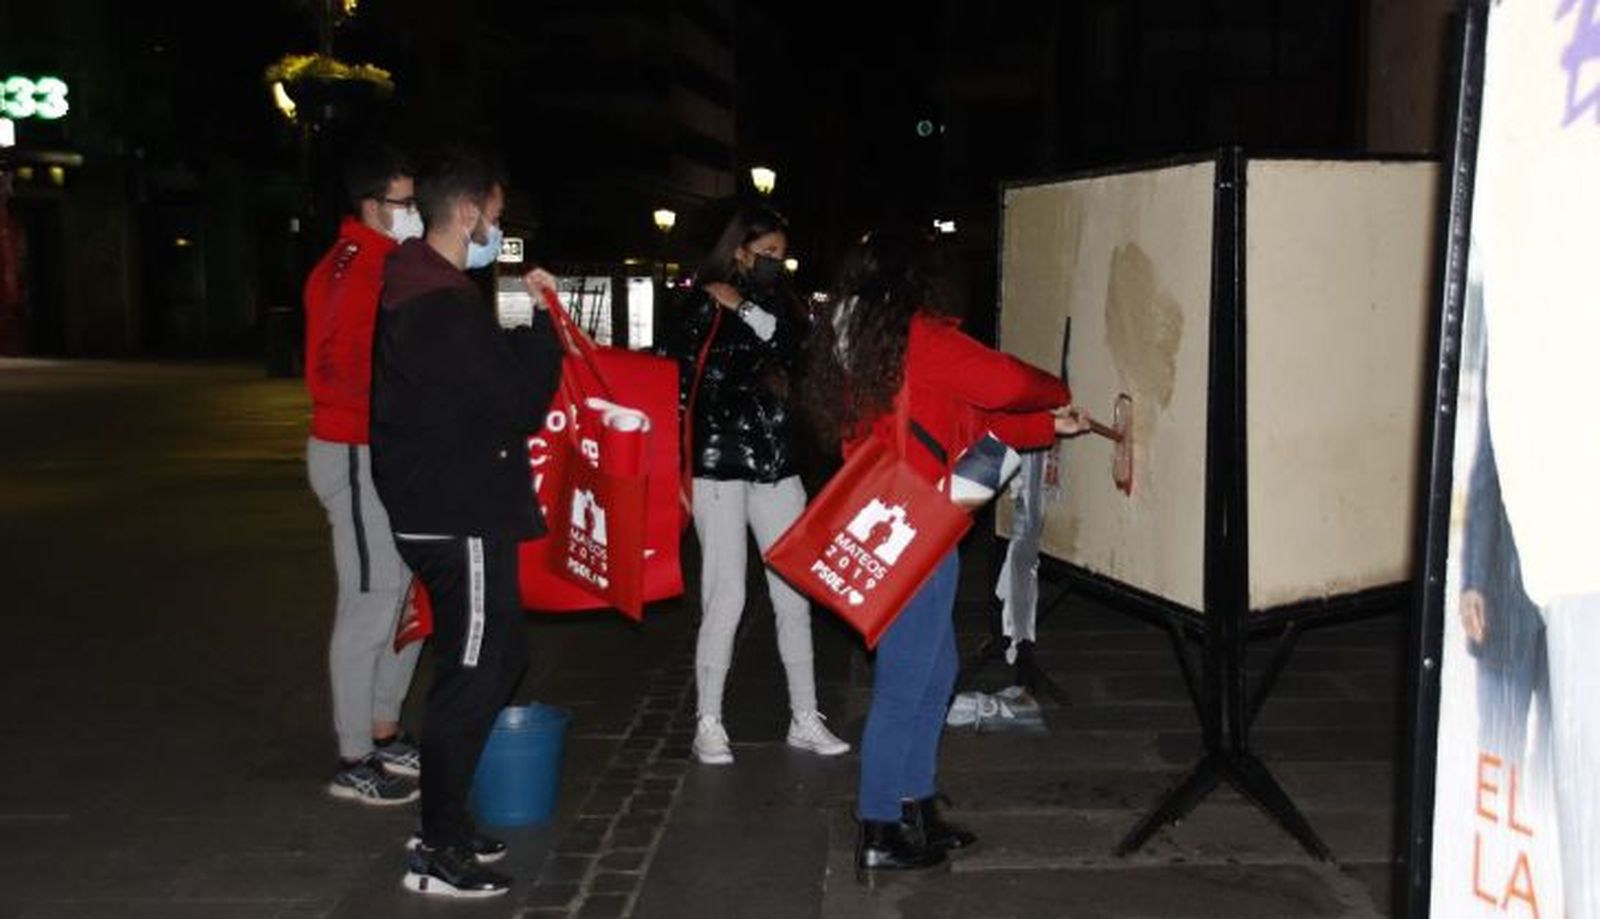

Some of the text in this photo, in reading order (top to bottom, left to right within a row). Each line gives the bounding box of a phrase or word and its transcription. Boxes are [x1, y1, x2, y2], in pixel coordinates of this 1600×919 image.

[0, 76, 69, 119] 33
[833, 532, 888, 580] MATEOS
[1476, 751, 1534, 837] EL
[1473, 832, 1541, 919] LA
